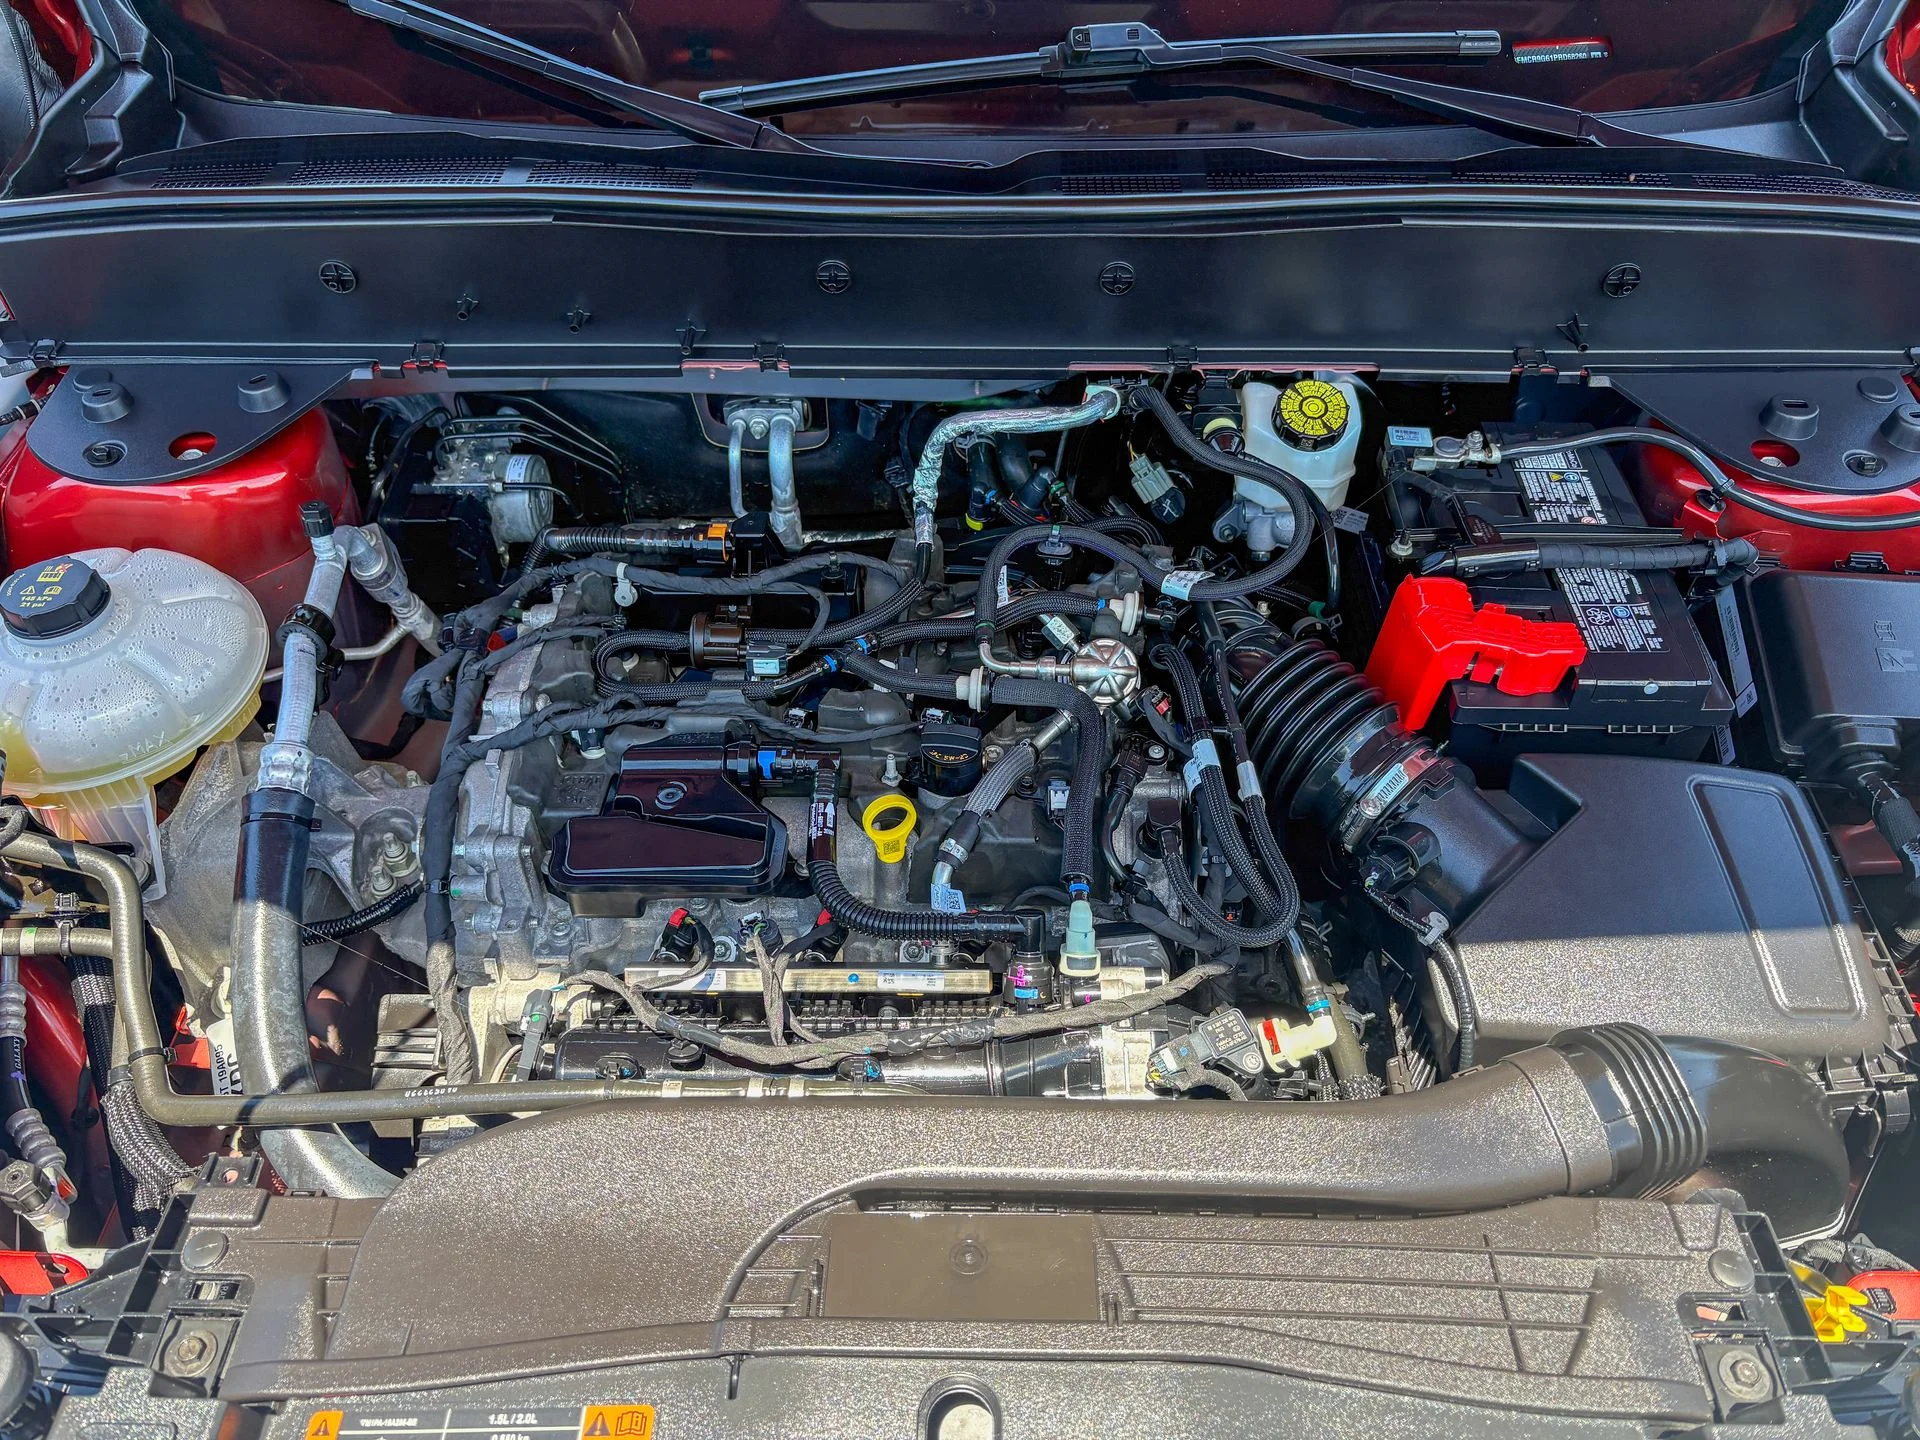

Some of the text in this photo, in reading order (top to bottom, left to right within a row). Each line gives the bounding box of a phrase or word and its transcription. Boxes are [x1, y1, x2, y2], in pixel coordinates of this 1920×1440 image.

[127, 730, 171, 758] MAX
[14, 1036, 22, 1069] GALAXY
[214, 1044, 228, 1083] 19A095
[516, 1413, 538, 1424] 2.0L
